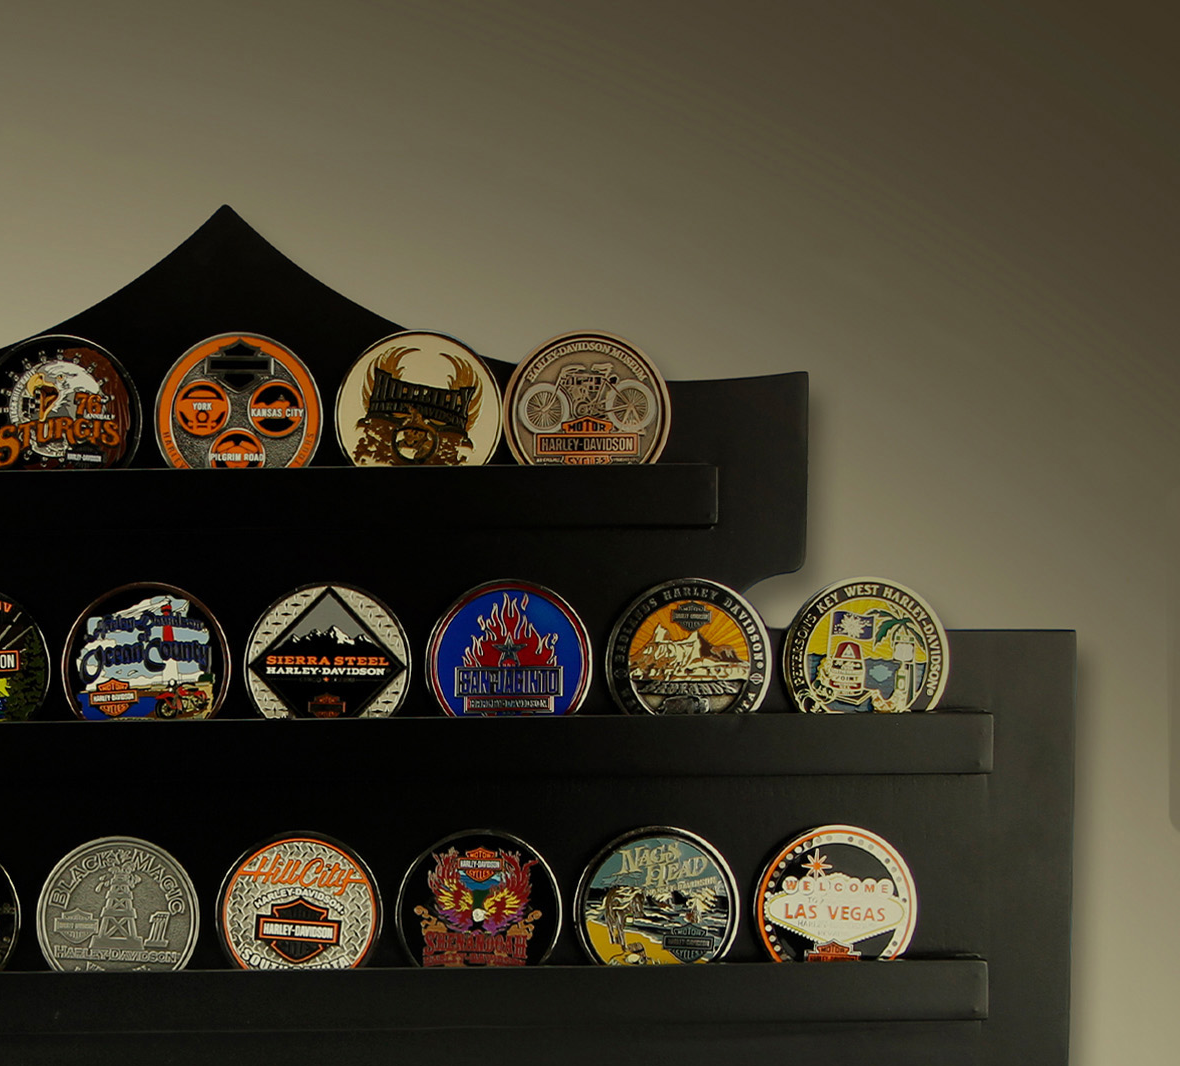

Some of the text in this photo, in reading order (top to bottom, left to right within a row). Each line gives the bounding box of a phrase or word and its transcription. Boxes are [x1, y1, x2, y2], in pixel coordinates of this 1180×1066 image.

[526, 341, 649, 384] HARLEY-DAVIDSON MUSEUM
[74, 393, 102, 415] 76
[192, 402, 213, 412] YORK
[251, 408, 304, 418] KANSAS CITY
[568, 421, 607, 432] MOTOR
[541, 437, 633, 452] HARLEY-DAVIDSON
[210, 453, 264, 463] PILGRIM ROAD
[816, 593, 840, 614] KEY
[843, 584, 880, 598] WEST
[662, 586, 720, 601] HARLEY
[723, 598, 765, 661] DAVIDSON
[80, 638, 212, 684] Ocean County
[265, 655, 390, 667] SIERRA STEEL
[49, 848, 186, 916] BLACK MAGIC
[241, 854, 367, 896] Hill City
[643, 856, 709, 888] HEAD
[785, 880, 889, 894] WELCOME
[784, 903, 886, 922] LAS VEGAS
[263, 922, 339, 940] HARLEY-DAVIDSON
[423, 931, 528, 960] SHENANDOAH
